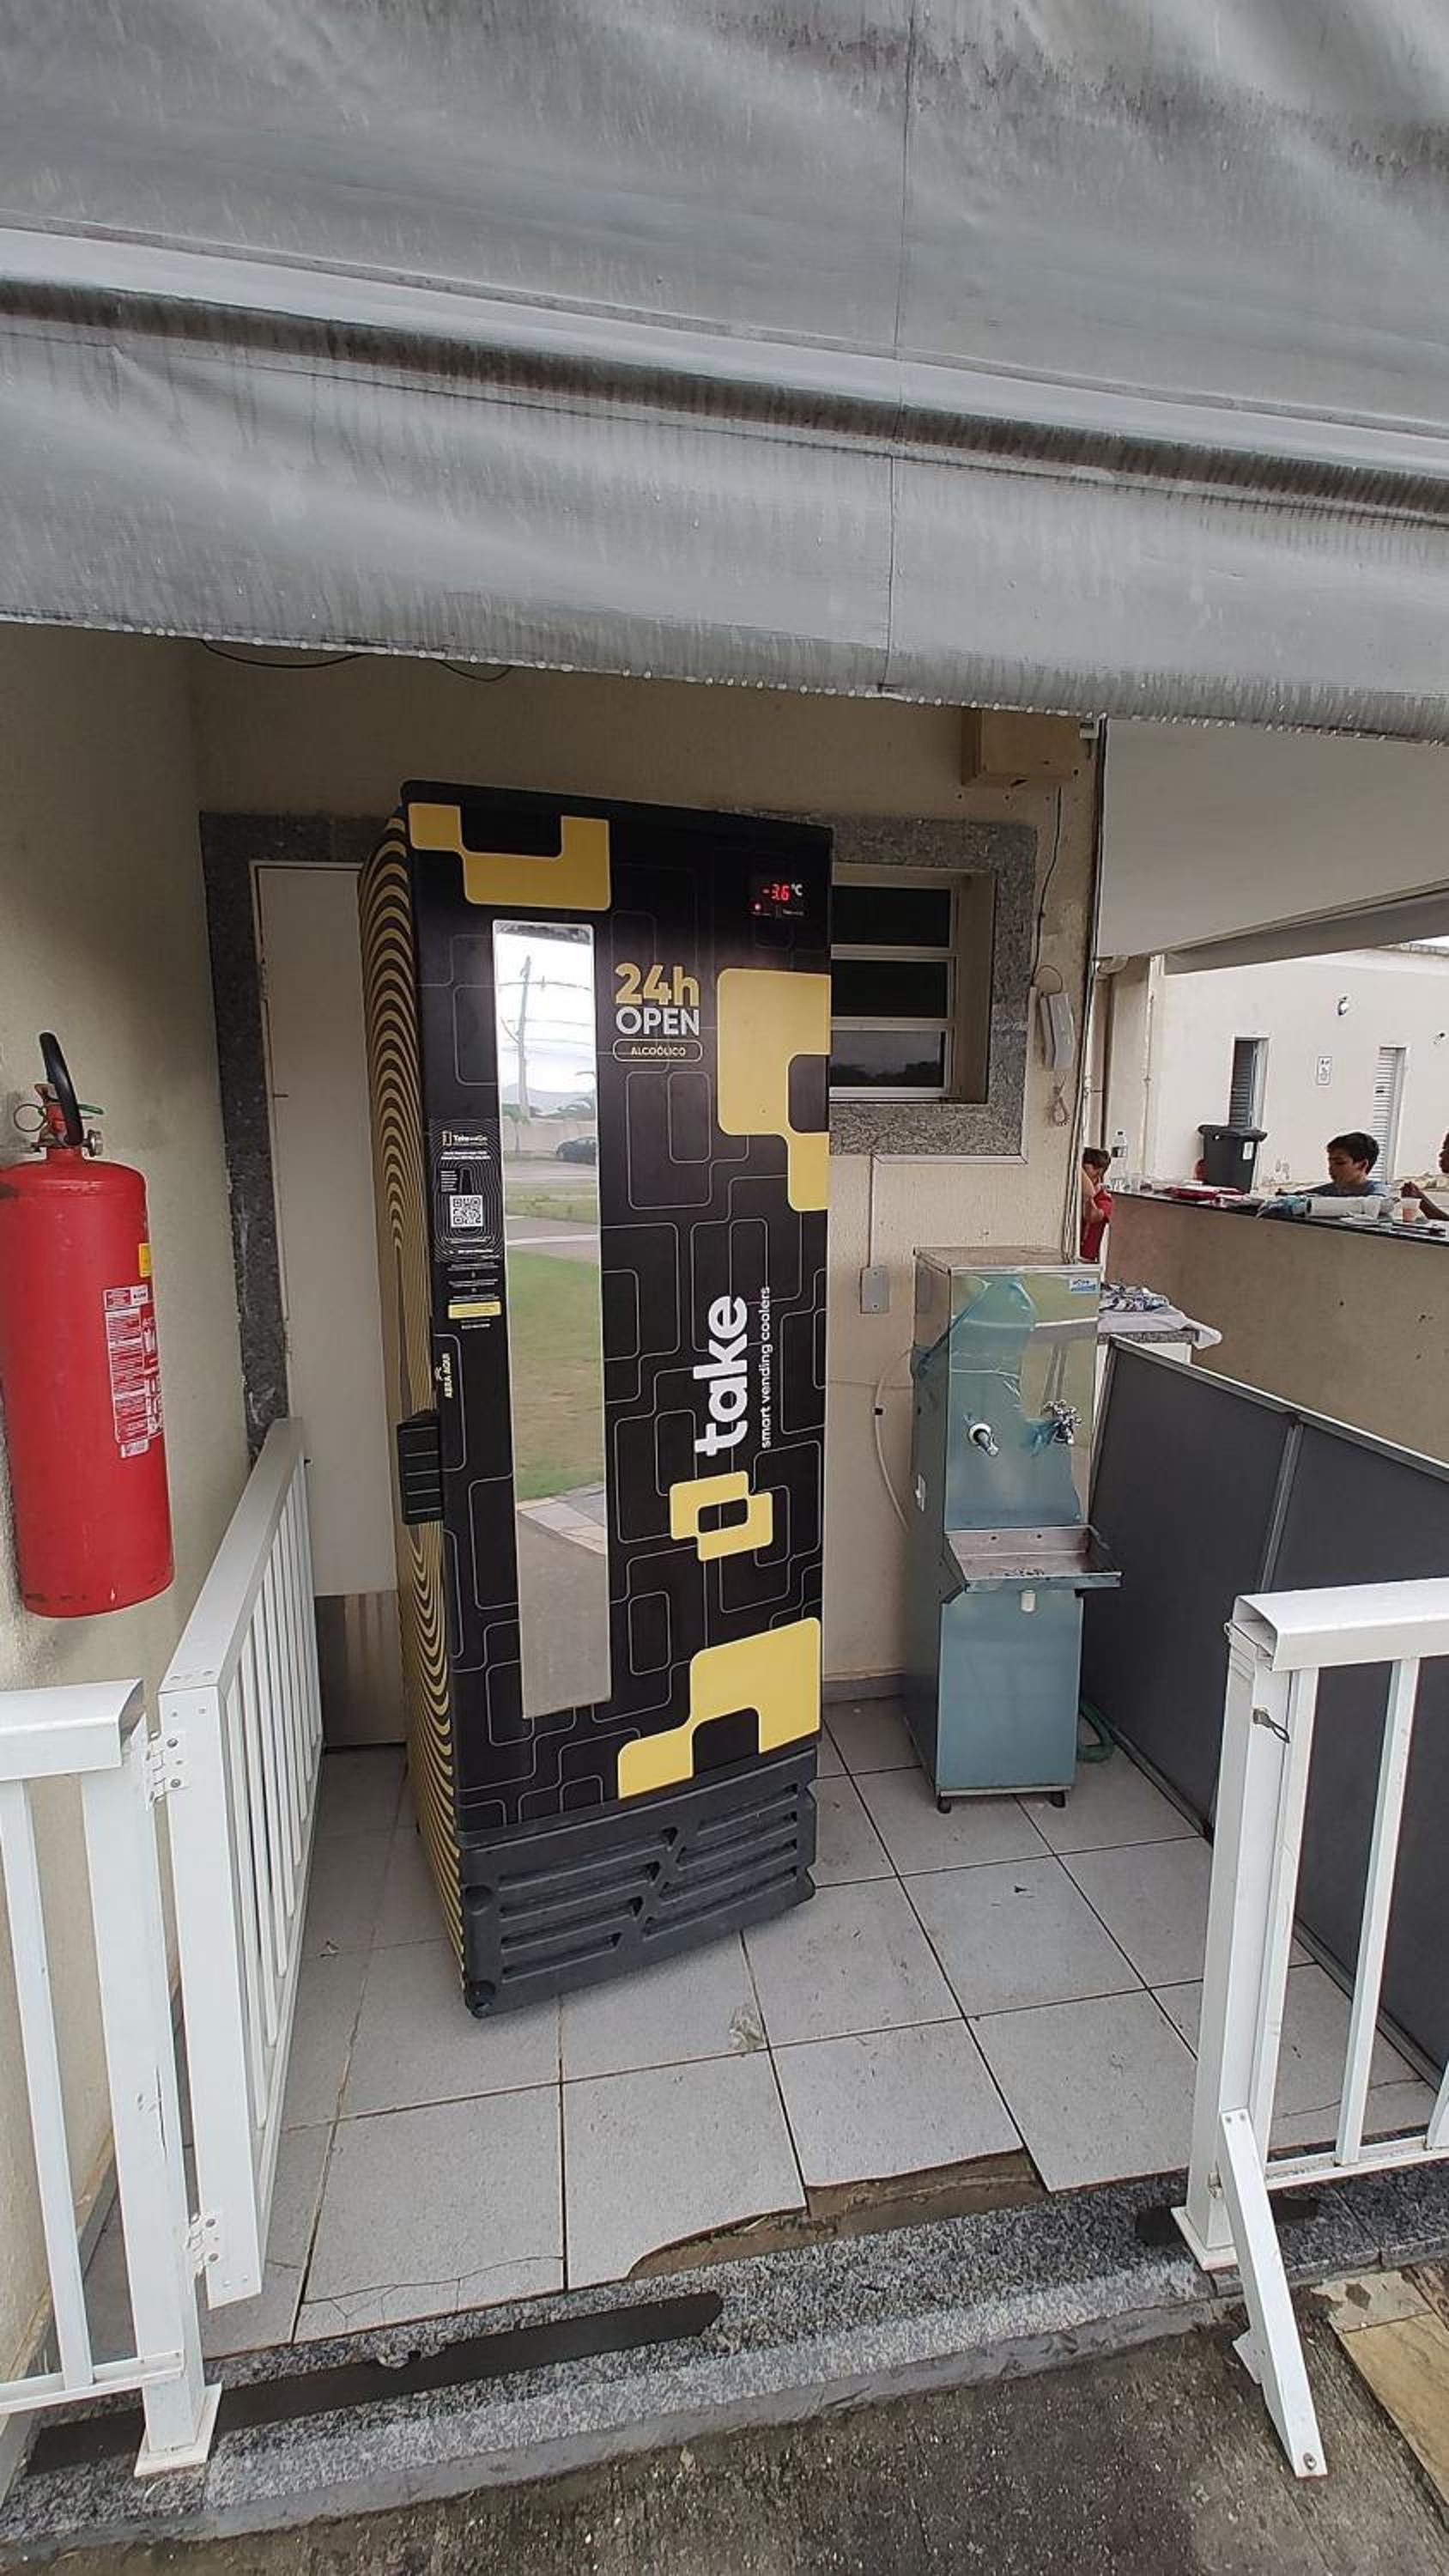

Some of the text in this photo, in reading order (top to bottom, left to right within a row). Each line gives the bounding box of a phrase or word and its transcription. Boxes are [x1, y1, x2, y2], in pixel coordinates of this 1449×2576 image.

[615, 963, 700, 1006] 24h
[615, 1005, 700, 1036] OPEN
[693, 1295, 749, 1456] take
[758, 1286, 773, 1449] smart vending coolers
